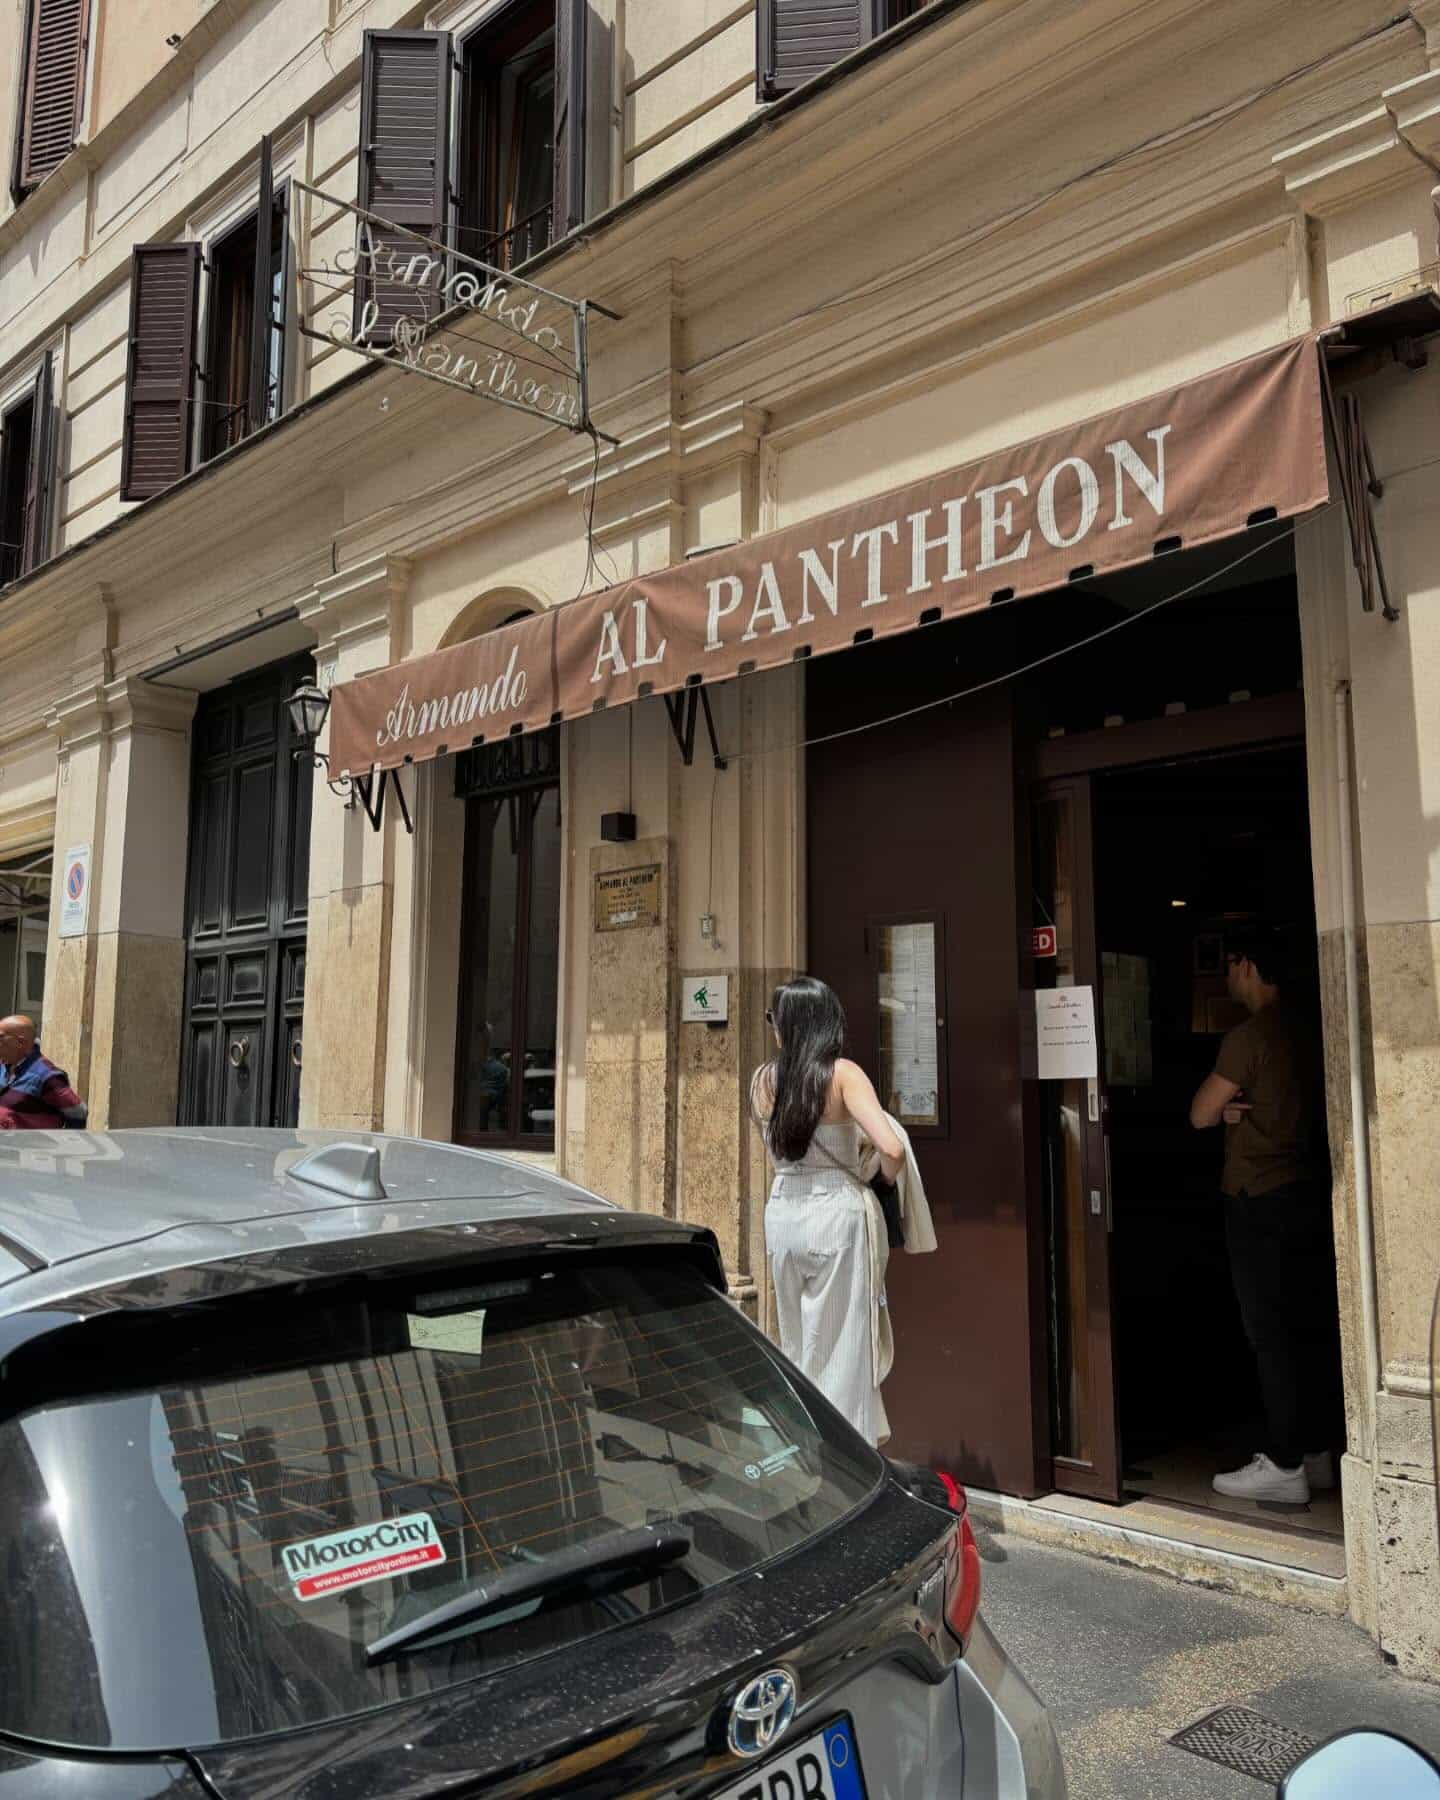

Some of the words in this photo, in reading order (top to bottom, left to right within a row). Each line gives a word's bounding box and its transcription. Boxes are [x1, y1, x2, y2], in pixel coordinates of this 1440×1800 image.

[376, 644, 528, 746] Armando
[590, 597, 667, 684] AL
[703, 424, 1172, 652] PANTHEON
[313, 1549, 430, 1589] www.motorcityonline.it
